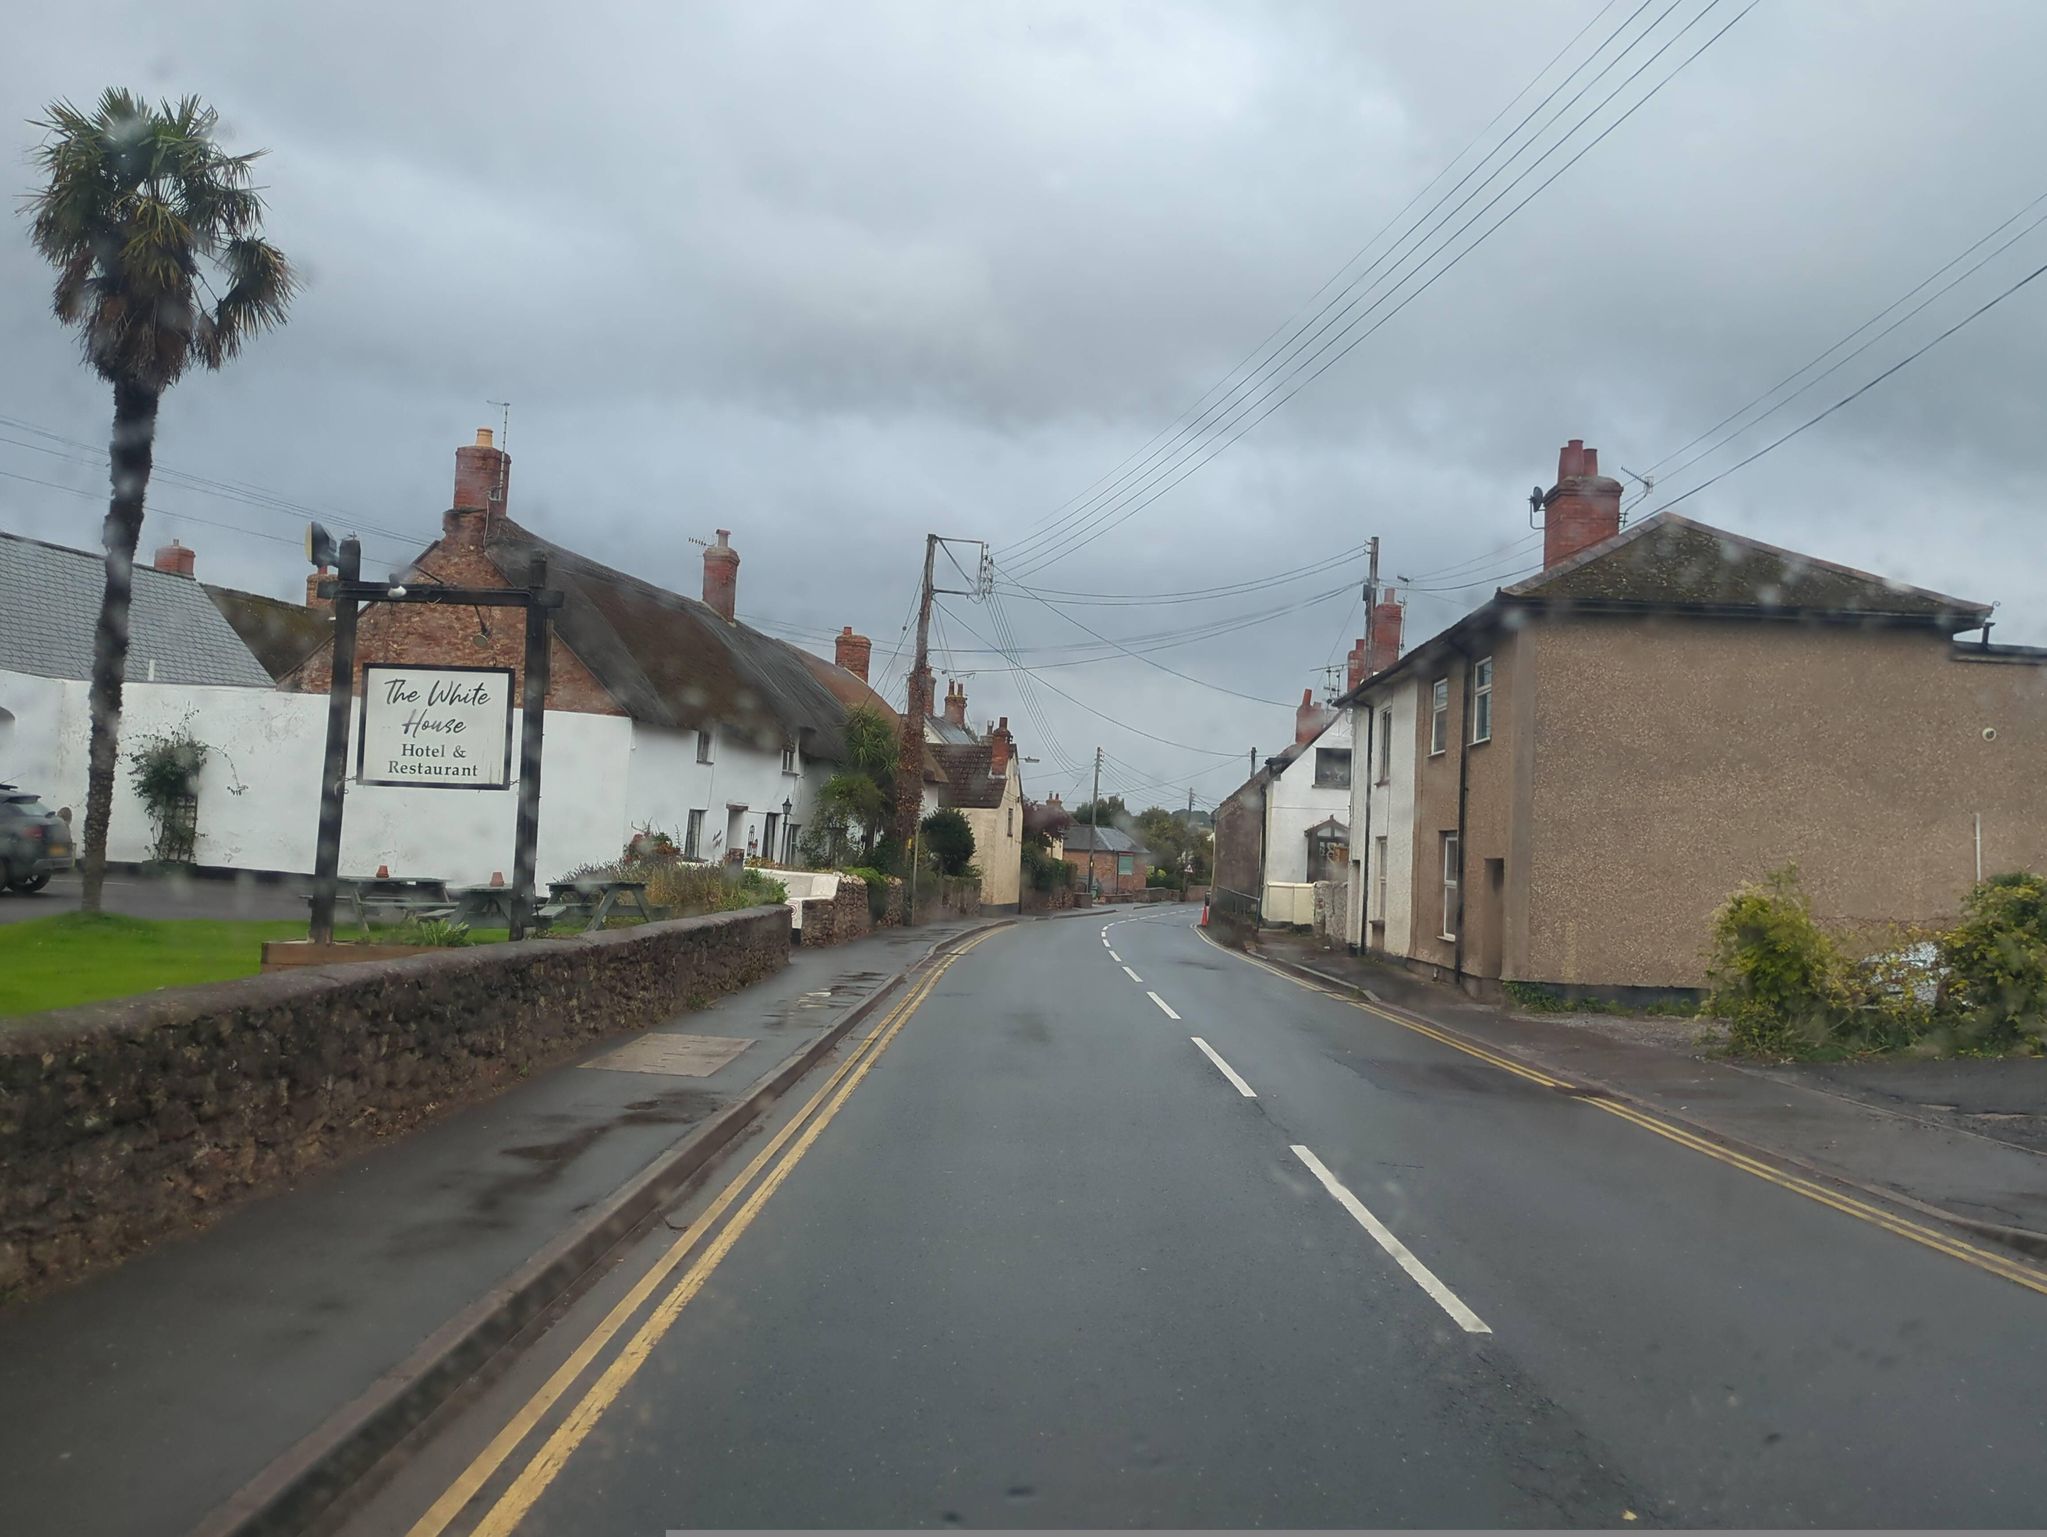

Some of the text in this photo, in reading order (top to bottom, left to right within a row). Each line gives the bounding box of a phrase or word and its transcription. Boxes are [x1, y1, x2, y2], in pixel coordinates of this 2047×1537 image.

[384, 679, 491, 706] The White
[402, 709, 466, 738] House
[401, 743, 466, 758] Hotel &
[388, 760, 478, 776] Restaurant
